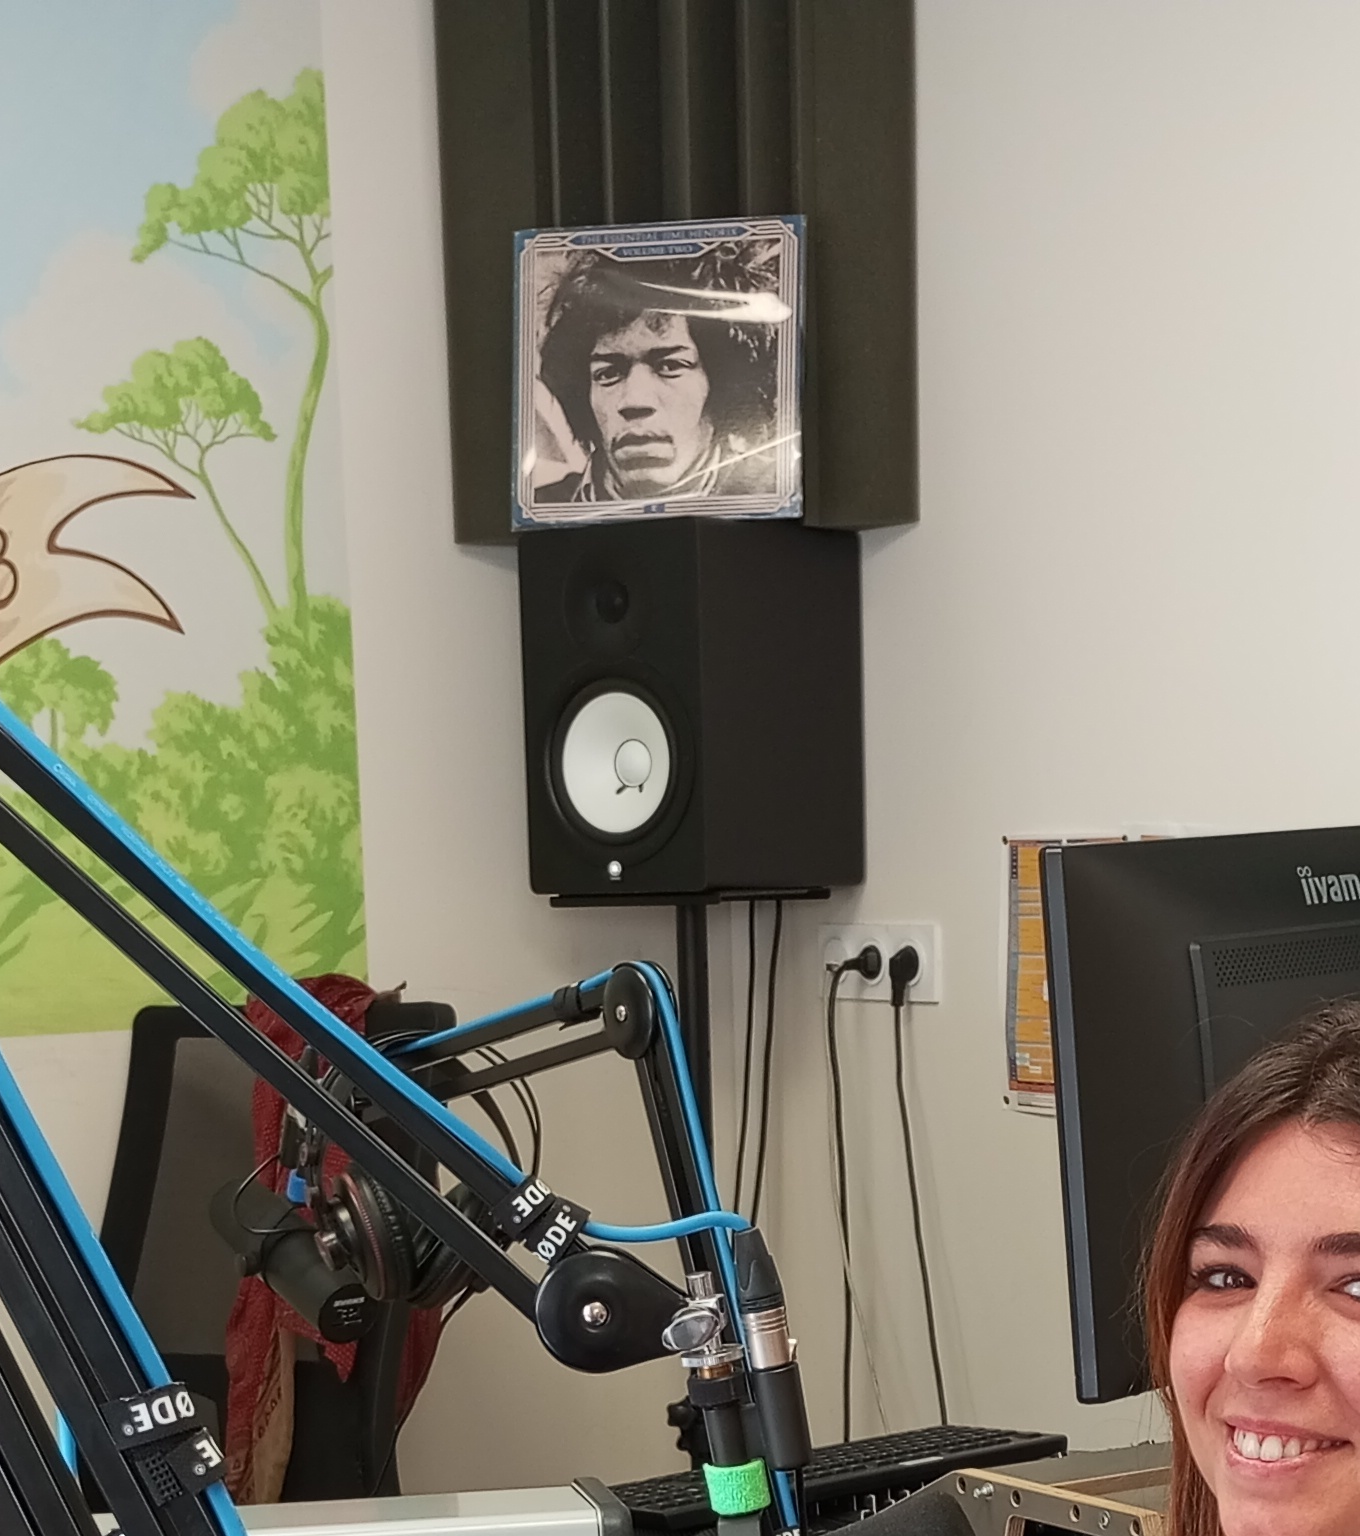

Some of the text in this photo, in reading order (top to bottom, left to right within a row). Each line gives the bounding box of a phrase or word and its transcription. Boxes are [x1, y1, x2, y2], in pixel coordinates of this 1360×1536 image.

[511, 1179, 551, 1218] ØDE
[533, 1211, 577, 1264] ØDE
[130, 1391, 195, 1433] ØDE
